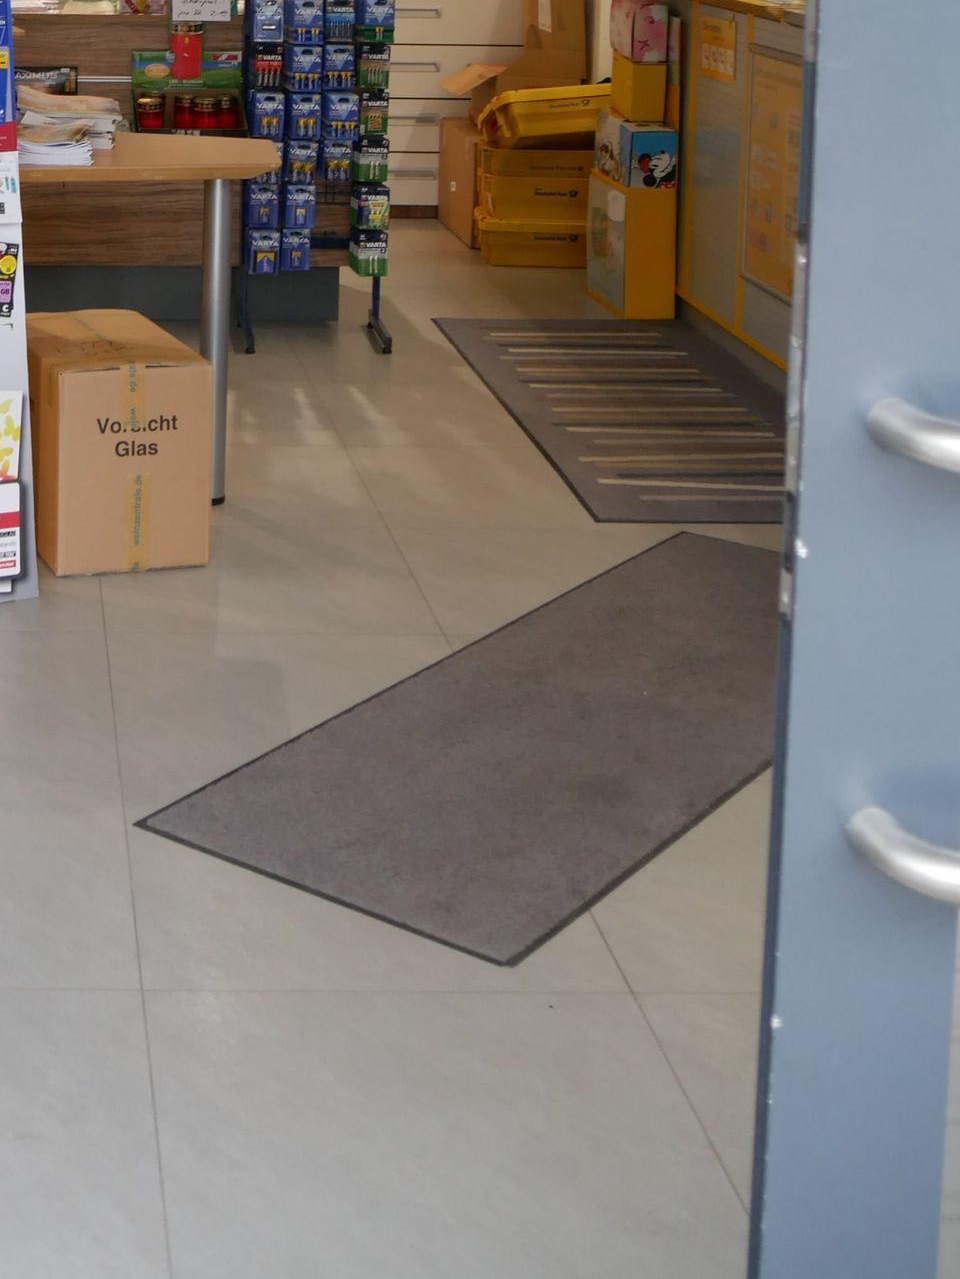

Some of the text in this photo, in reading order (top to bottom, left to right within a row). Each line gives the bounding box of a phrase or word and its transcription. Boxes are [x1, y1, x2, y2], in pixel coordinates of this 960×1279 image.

[255, 6, 283, 15] VARTA
[294, 8, 322, 17] VARTA
[367, 7, 394, 16] VARTA
[294, 55, 322, 64] VARTA
[327, 54, 354, 62] VARTA
[257, 102, 284, 111] VARTA
[292, 103, 320, 112] VARTA
[330, 104, 358, 112] VARTA
[290, 148, 317, 158] VARTA
[324, 146, 352, 155] VARTA
[251, 193, 278, 202] VARTA
[288, 194, 316, 202] VARTA
[252, 240, 279, 248] VARTA
[283, 236, 310, 245] VARTA
[96, 415, 178, 434] Vocht
[114, 440, 159, 458] Glas
